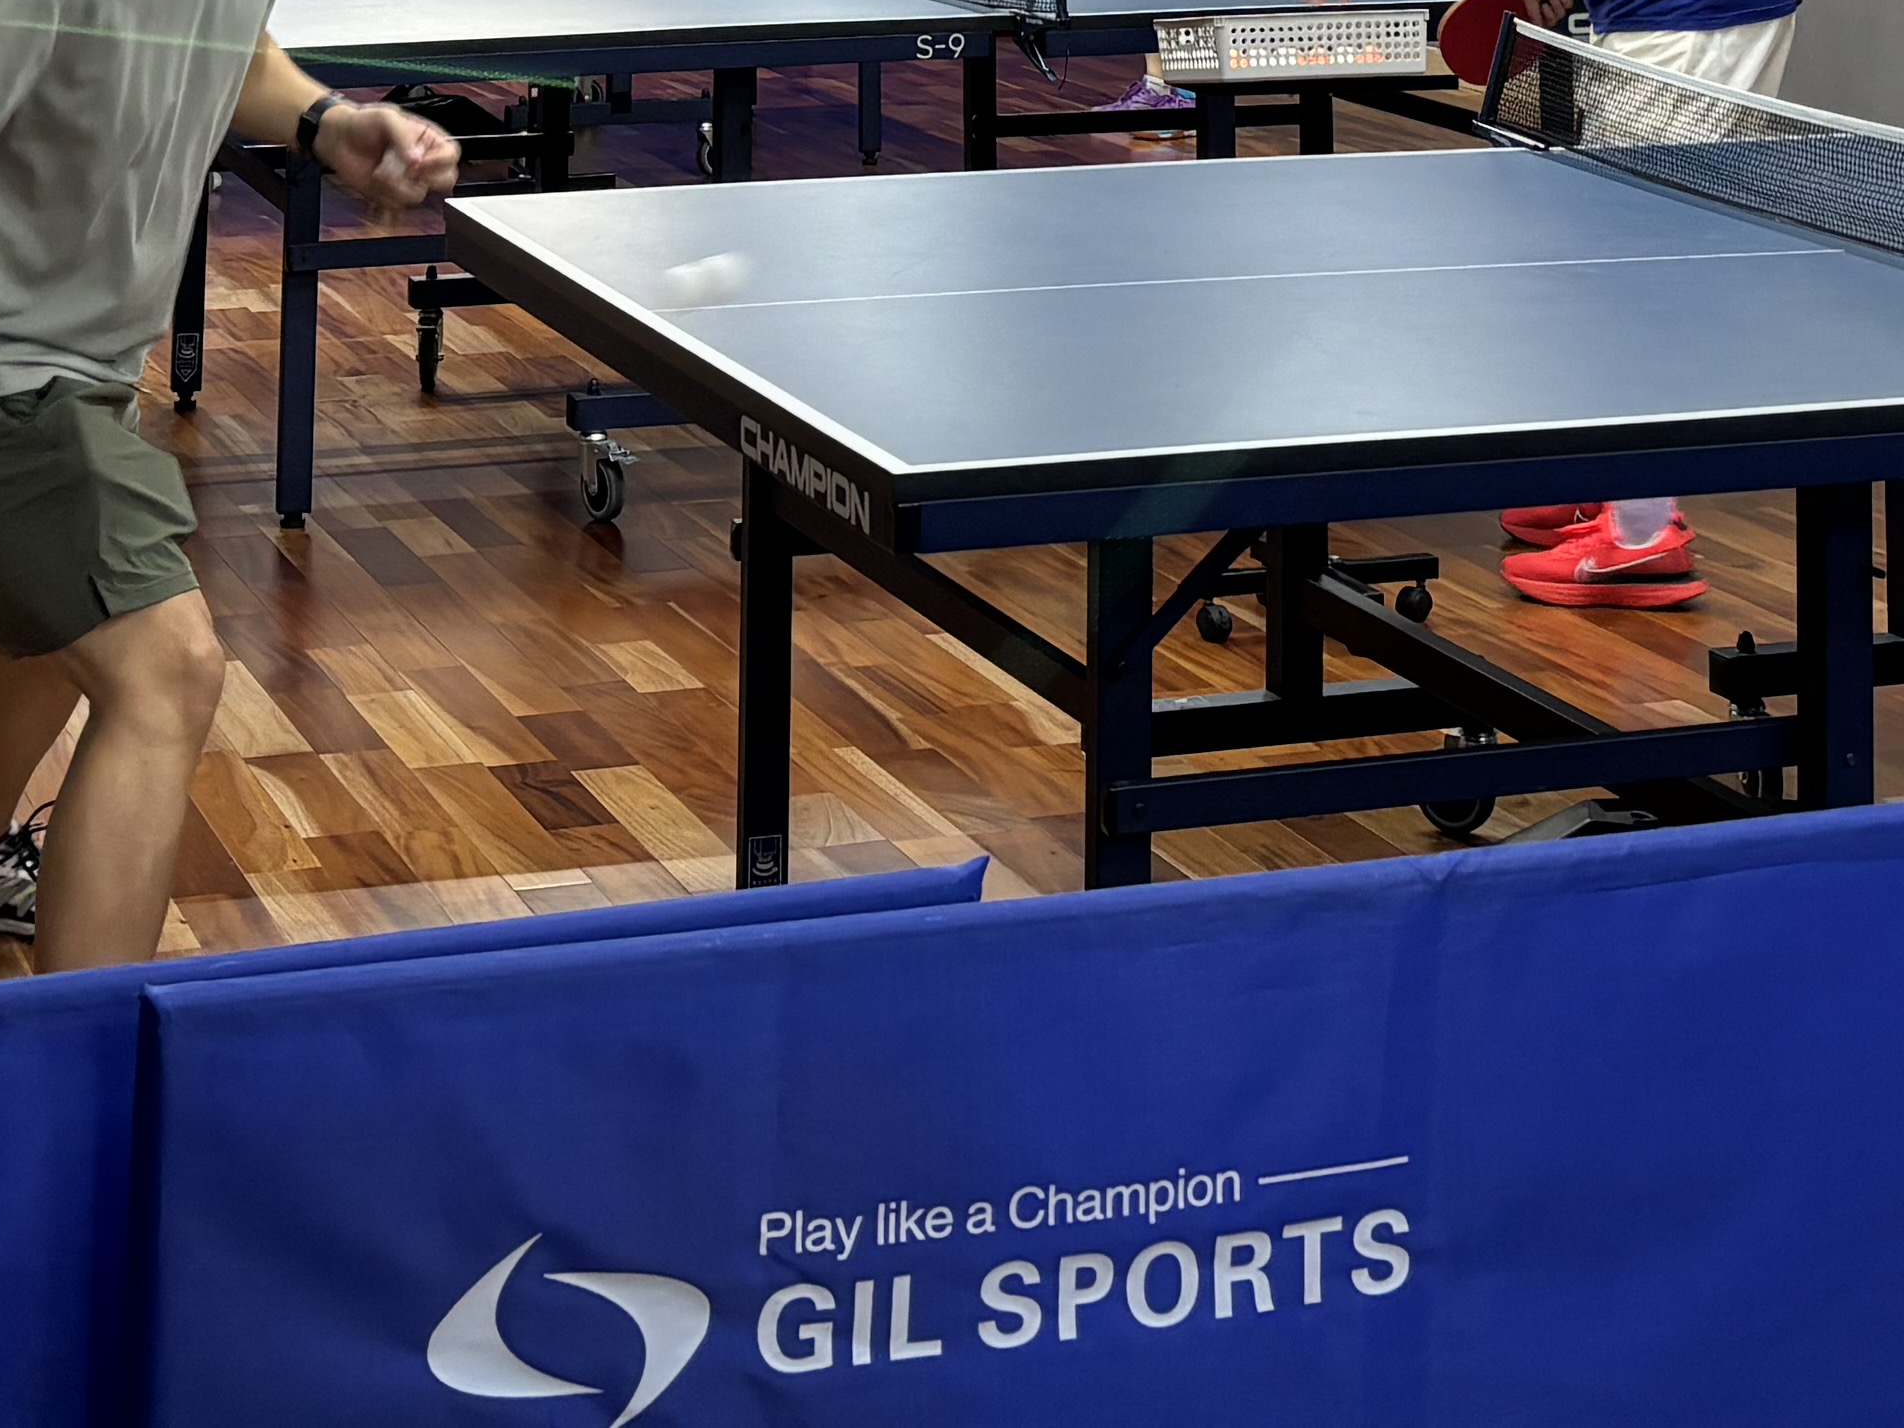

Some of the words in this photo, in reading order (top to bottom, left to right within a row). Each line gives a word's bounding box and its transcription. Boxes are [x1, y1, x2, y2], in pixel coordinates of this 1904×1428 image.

[915, 33, 966, 59] S-9
[740, 415, 870, 535] CHAMPION
[759, 1209, 863, 1261] Play
[876, 1200, 954, 1246] like
[966, 1201, 996, 1235] a
[1008, 1166, 1242, 1230] Champion
[757, 1275, 943, 1374] GIL
[977, 1207, 1411, 1350] SPORTS
